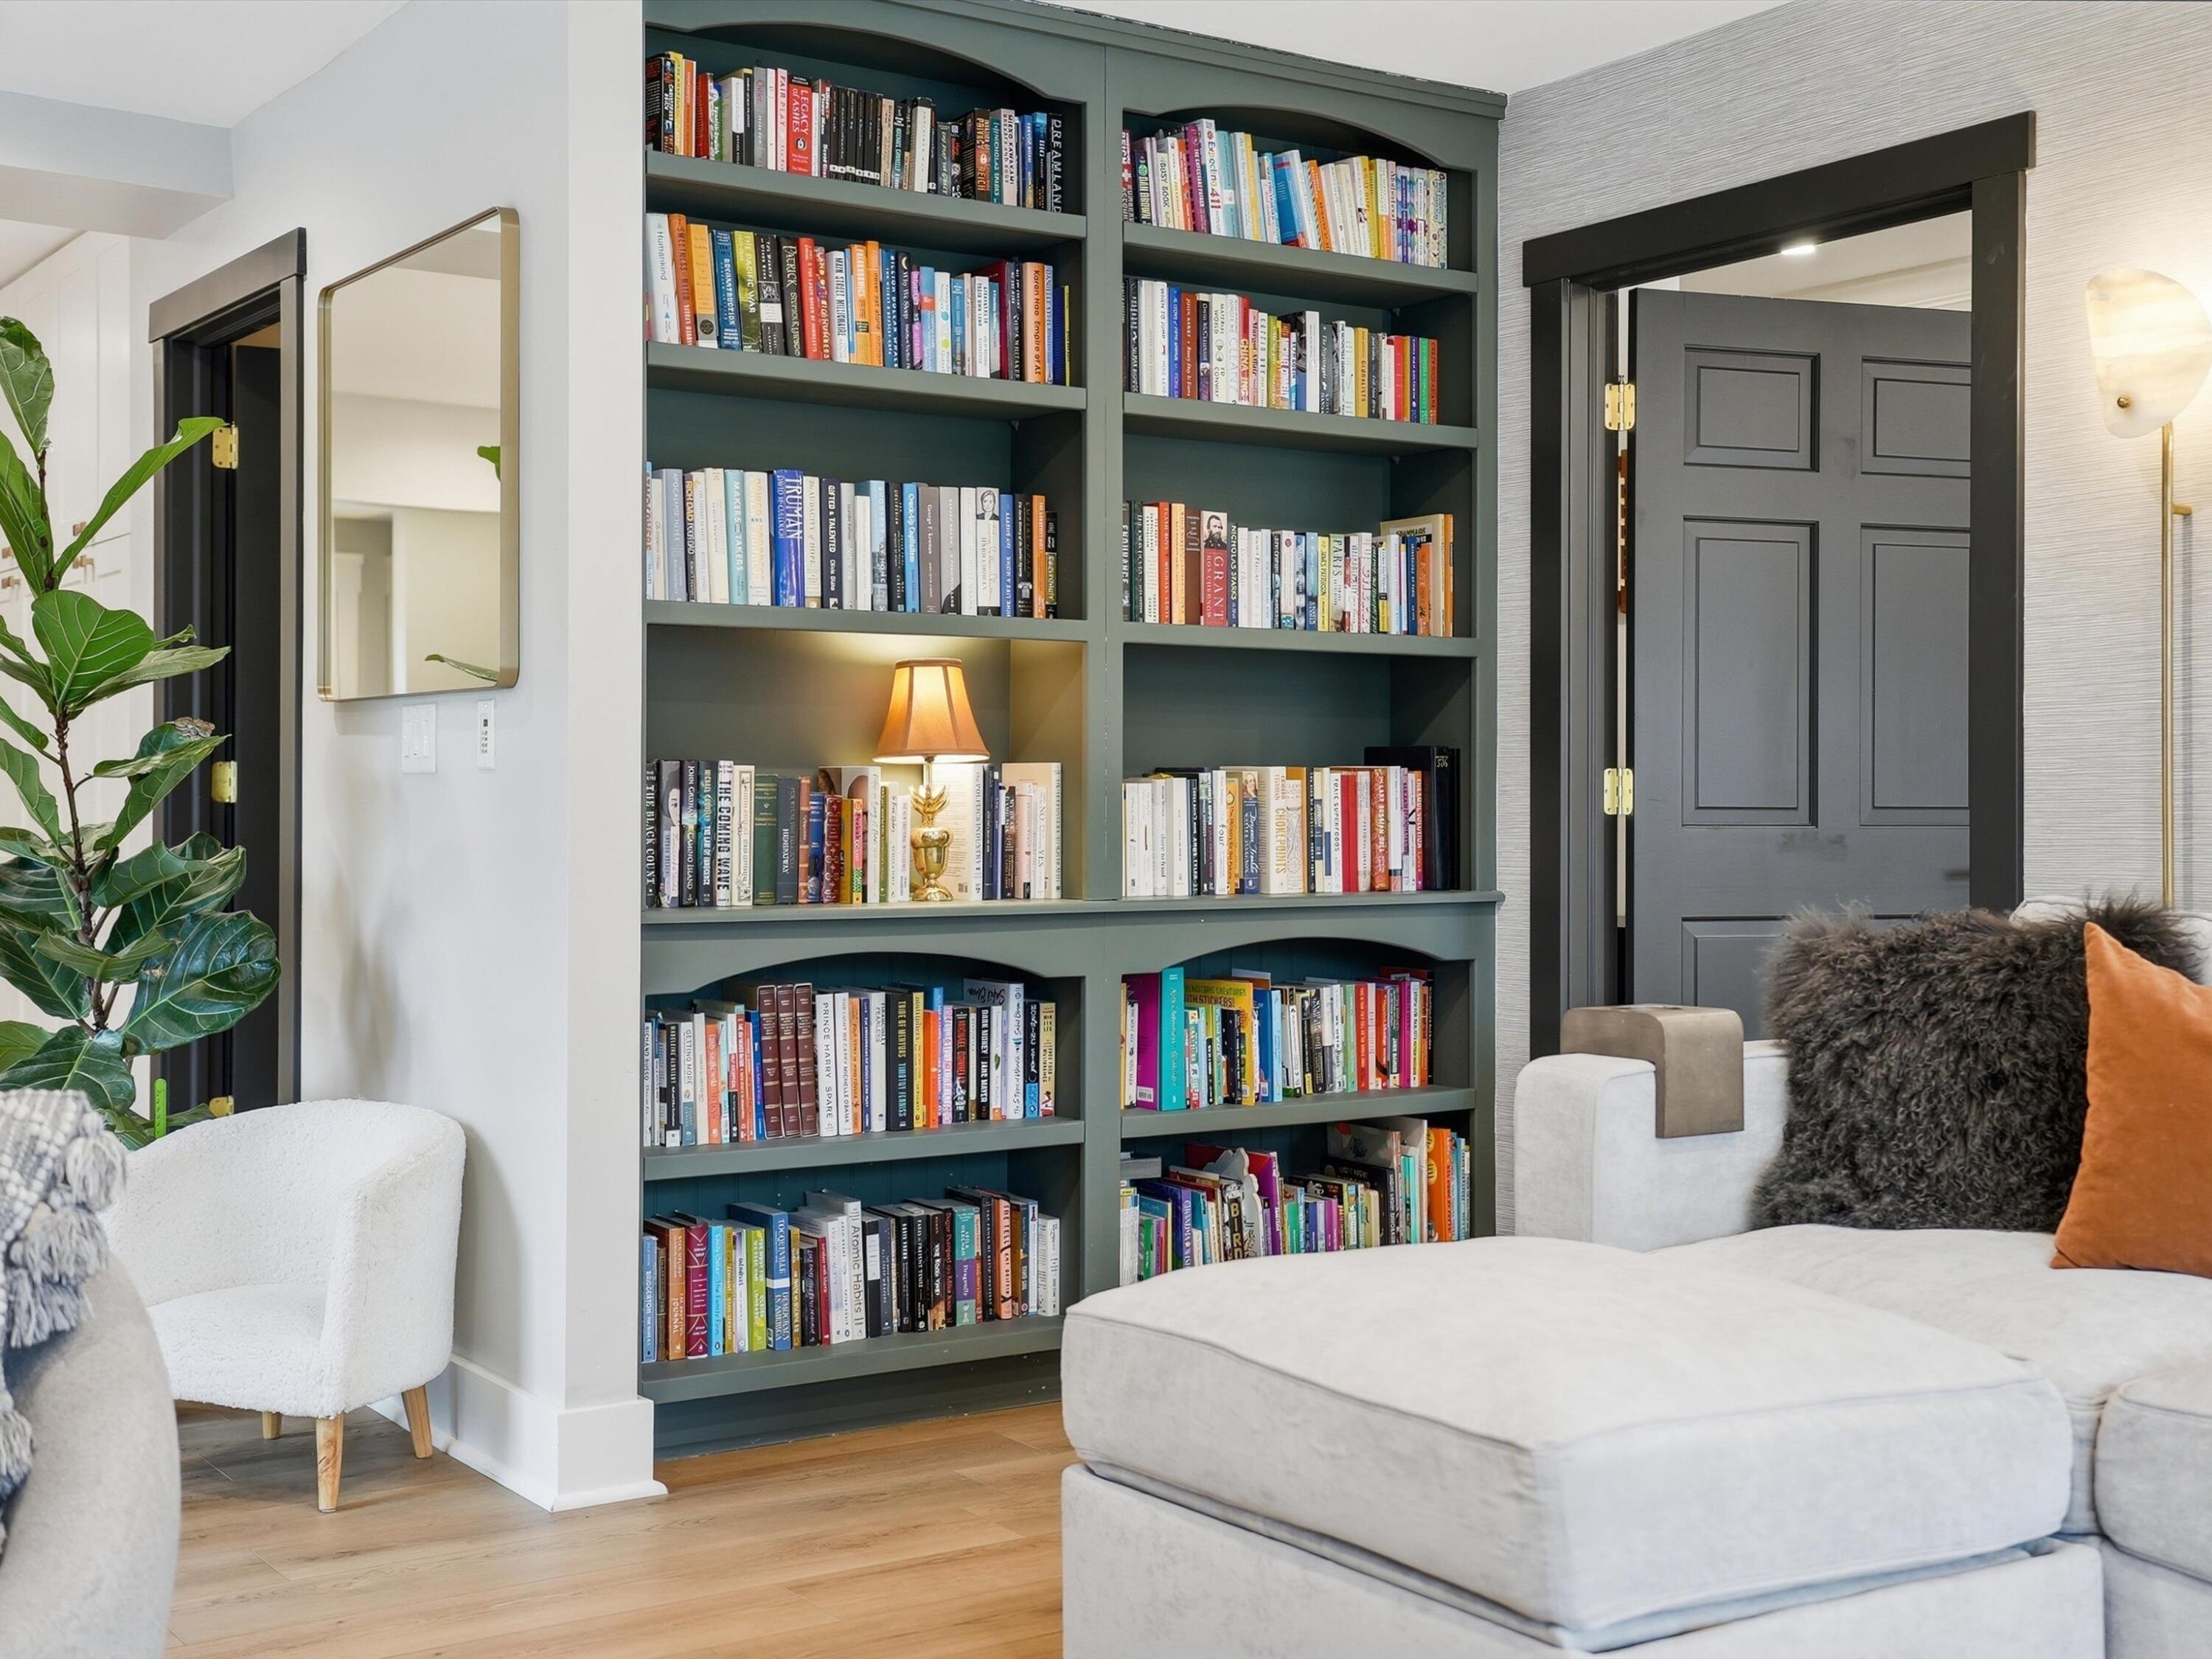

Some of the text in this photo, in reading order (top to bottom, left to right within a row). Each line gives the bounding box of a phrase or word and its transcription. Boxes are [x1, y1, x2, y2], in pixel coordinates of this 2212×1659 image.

[801, 89, 809, 135] LEGACY
[1051, 119, 1062, 212] DREAMLAND
[1160, 163, 1168, 182] BUSY
[1208, 141, 1221, 209] Expecting 411
[1139, 176, 1151, 219] DAN BROWN
[656, 232, 667, 280] Humankind
[746, 254, 755, 288] PACIFIC
[783, 246, 797, 288] PATRICK
[1229, 338, 1238, 383] CLEAN
[1240, 338, 1248, 372] CHINA
[733, 481, 743, 571] MAKERS TAKERS
[785, 477, 802, 539] TRUMAN
[1333, 538, 1342, 576] PARIS
[1214, 556, 1224, 620] GRANT
[646, 785, 655, 807] THE
[646, 811, 655, 844] BLACK
[717, 780, 731, 891] THE COMING WAVE
[1218, 824, 1227, 846] four
[1275, 808, 1286, 874] CHOKEPOINTS
[646, 848, 655, 885] COUNT
[703, 857, 711, 886] INNOCENCE
[898, 1019, 906, 1027] OF
[957, 1020, 967, 1048] MICHAEL
[777, 1219, 786, 1275] TOCQUEVILLE
[851, 1225, 863, 1313] Atomic Habits
[775, 1295, 783, 1341] IN AMERICA
[782, 1292, 790, 1340] DEMOCRACY
